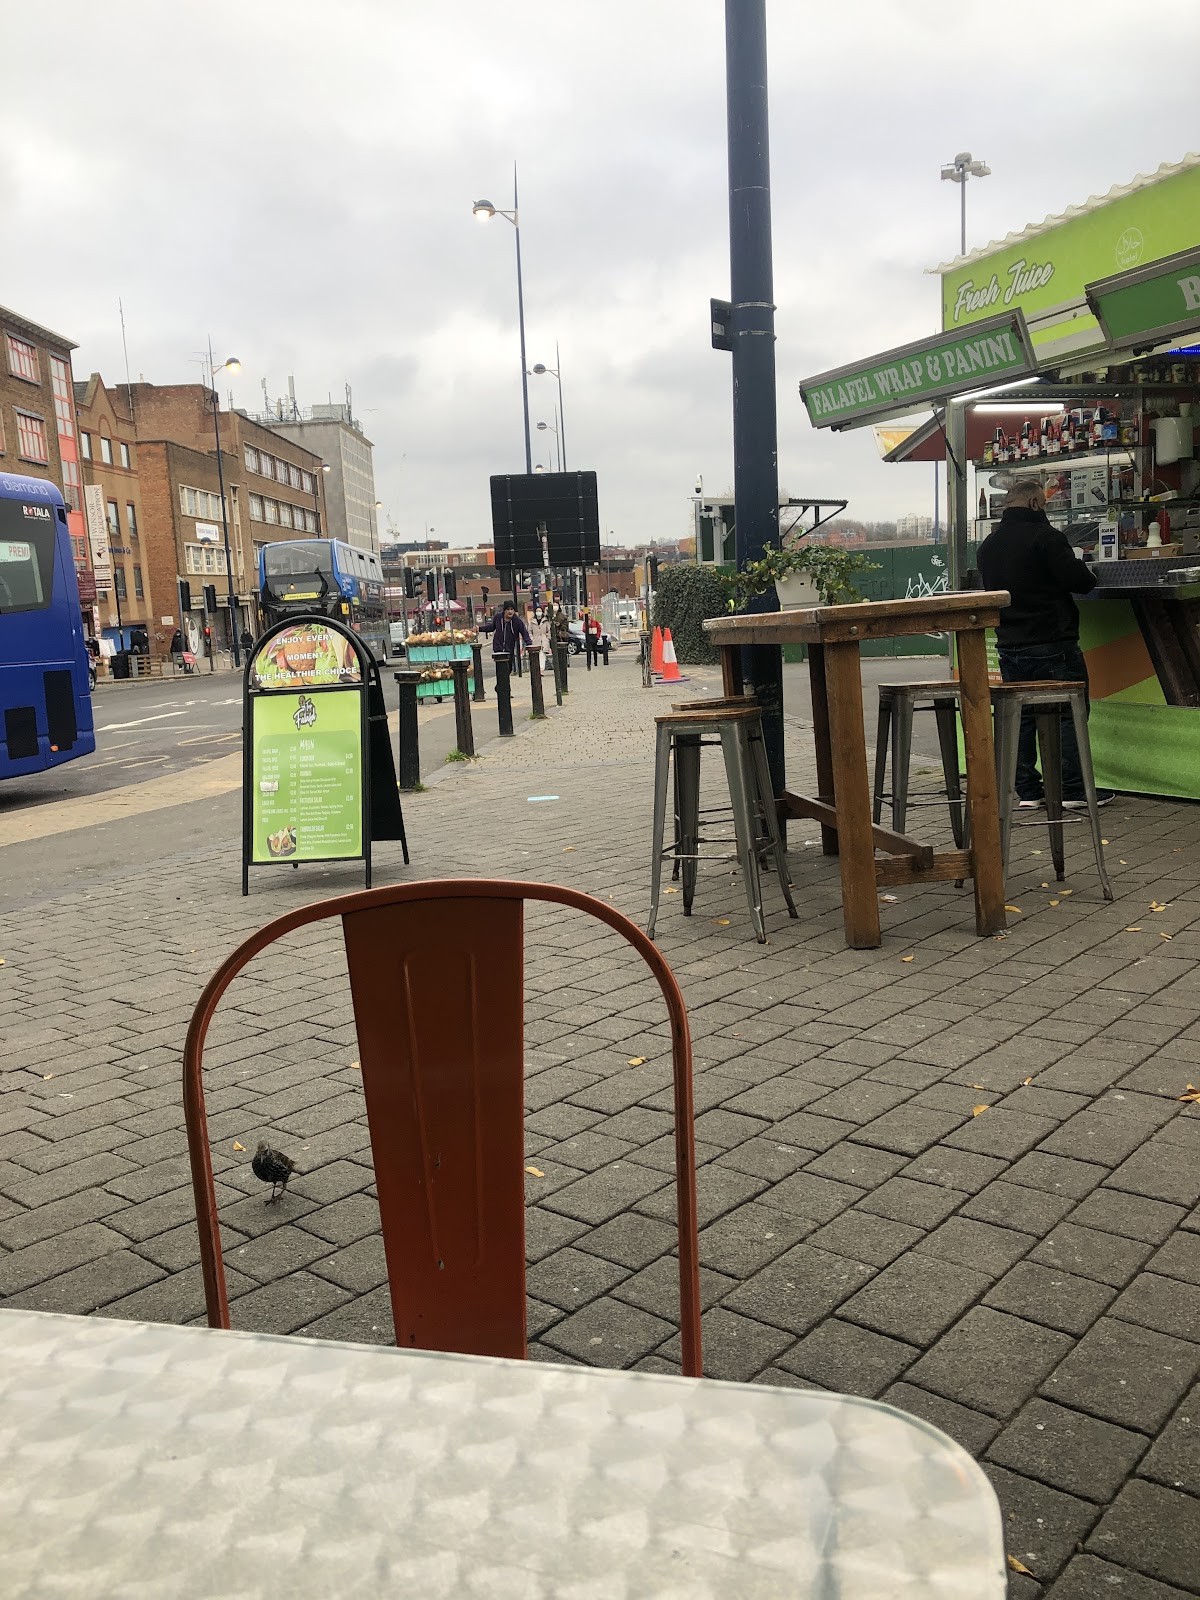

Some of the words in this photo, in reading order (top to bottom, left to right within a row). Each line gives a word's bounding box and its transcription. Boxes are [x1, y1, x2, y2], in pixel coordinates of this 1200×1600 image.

[1121, 251, 1138, 264] halal
[953, 273, 1001, 322] Fresh
[1004, 257, 1055, 305] Juice
[810, 376, 876, 415] FALAFEL
[873, 360, 923, 396] WRAP
[925, 355, 942, 382] &
[941, 332, 1017, 378] PANINI
[3, 479, 48, 496] diamond
[22, 505, 50, 518] ROTALA
[89, 502, 98, 534] WINSOR
[276, 636, 304, 645] ENJOY
[306, 633, 335, 642] EVERY
[286, 652, 324, 661] MOMENT
[274, 669, 322, 679] HEALTHIER
[324, 666, 358, 675] CHIOCE
